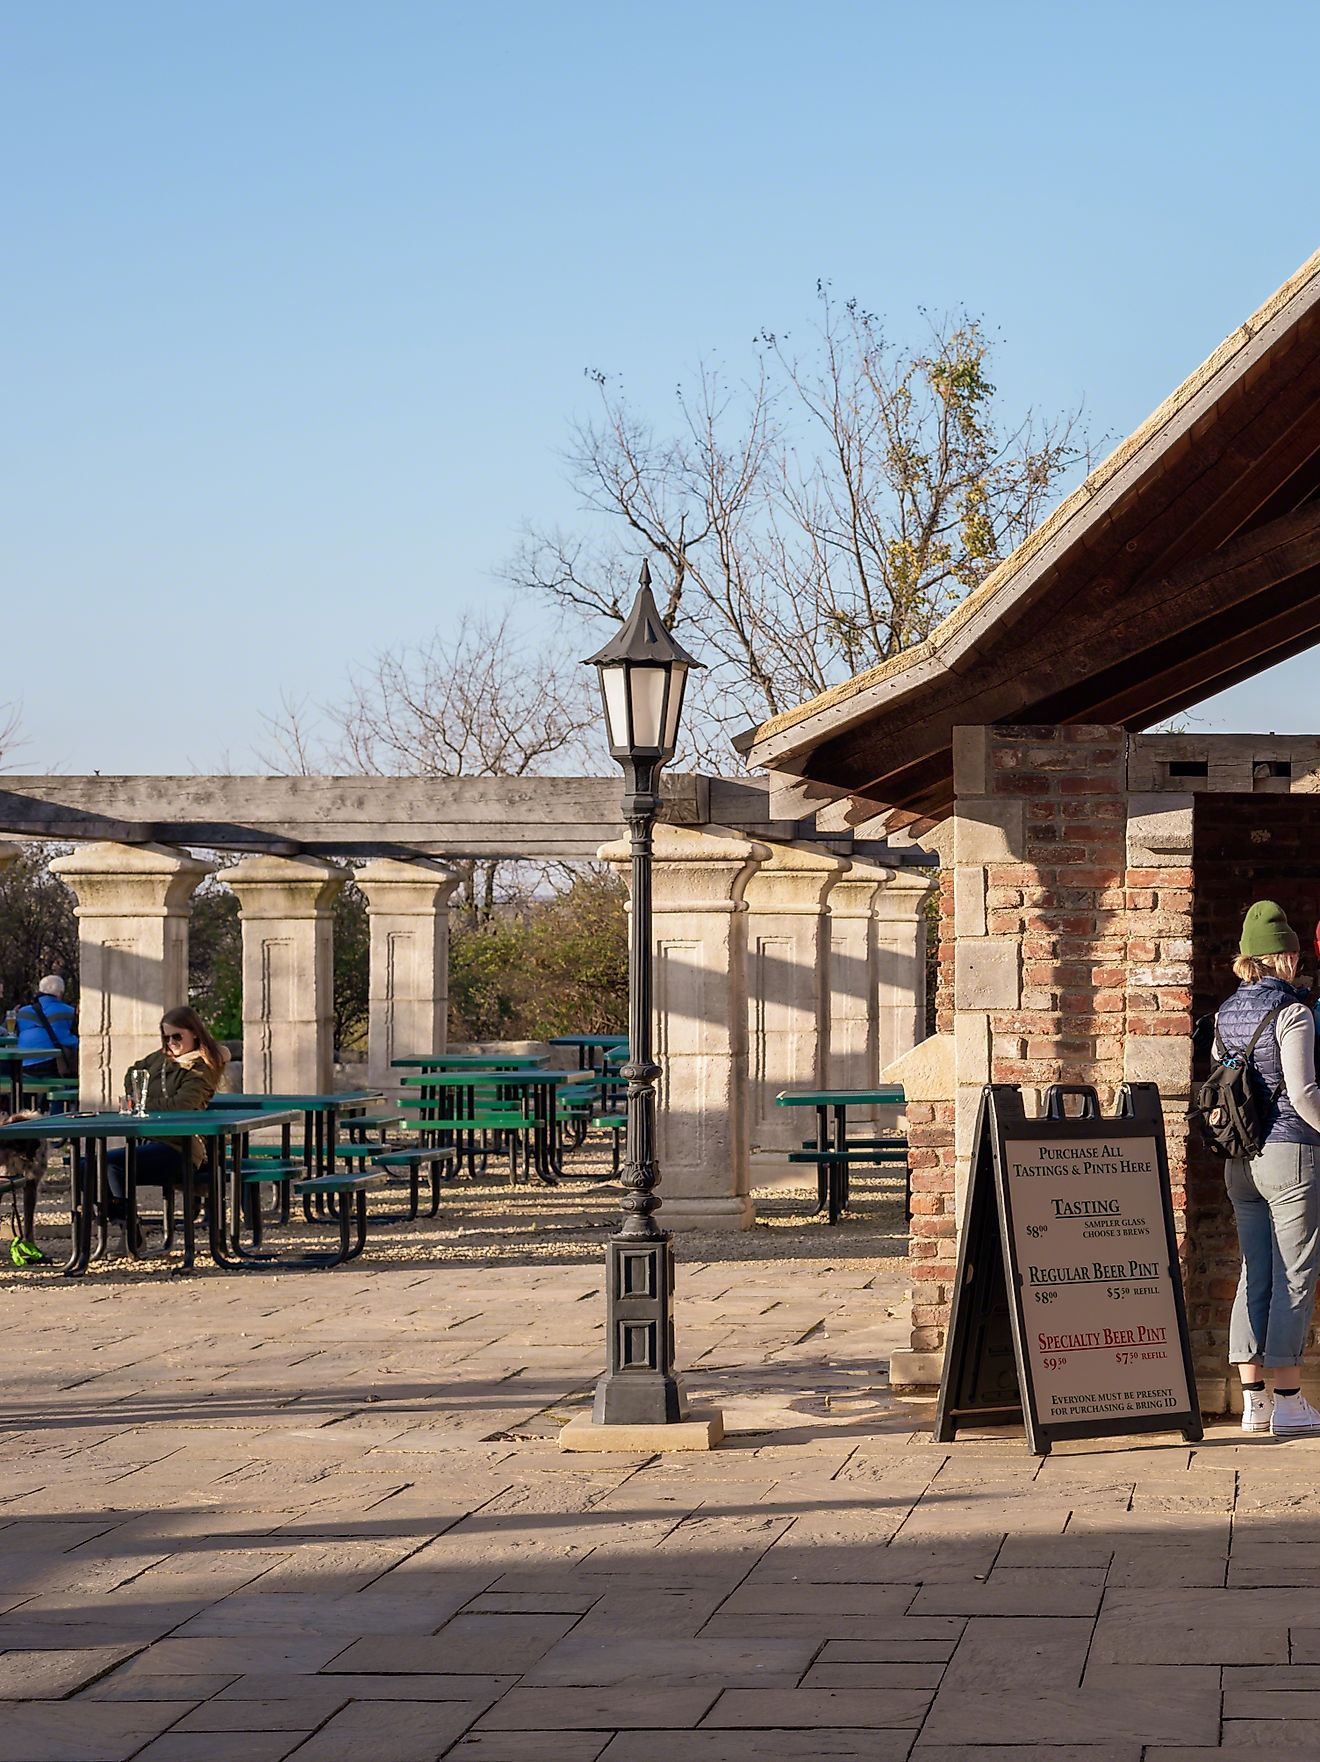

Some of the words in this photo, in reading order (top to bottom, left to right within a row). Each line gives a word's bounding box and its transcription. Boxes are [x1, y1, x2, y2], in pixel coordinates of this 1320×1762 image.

[1039, 1147, 1098, 1160] PURCHASE
[1101, 1145, 1123, 1158] ALL
[1013, 1164, 1069, 1177] TASTINGS
[1071, 1165, 1081, 1175] &
[1083, 1162, 1118, 1175] PINTS
[1120, 1160, 1151, 1173] HERE
[1051, 1199, 1121, 1216] TASTING
[1084, 1219, 1121, 1229] SAMPLER
[1121, 1218, 1146, 1227] GLASS
[1083, 1229, 1116, 1239] CHOOSE
[1123, 1227, 1150, 1237] BREWS
[1029, 1265, 1090, 1283] REGULAR
[1092, 1262, 1127, 1279] BEER
[1128, 1260, 1159, 1277] PINT
[1133, 1287, 1160, 1295] REFILL
[1038, 1331, 1101, 1350] SPECIALTY
[1103, 1328, 1137, 1345] BEER
[1137, 1325, 1167, 1342] PINT
[1141, 1351, 1168, 1360] REFILL
[1051, 1394, 1096, 1405] EVERYONE
[1098, 1392, 1122, 1401] MUST
[1124, 1391, 1135, 1399] BE
[1136, 1388, 1173, 1398] PRESENT
[1051, 1407, 1068, 1416] FOR
[1070, 1403, 1125, 1415] PURCHASING
[1126, 1402, 1134, 1410] &
[1136, 1400, 1163, 1410] BRING
[1164, 1397, 1177, 1408] ID
